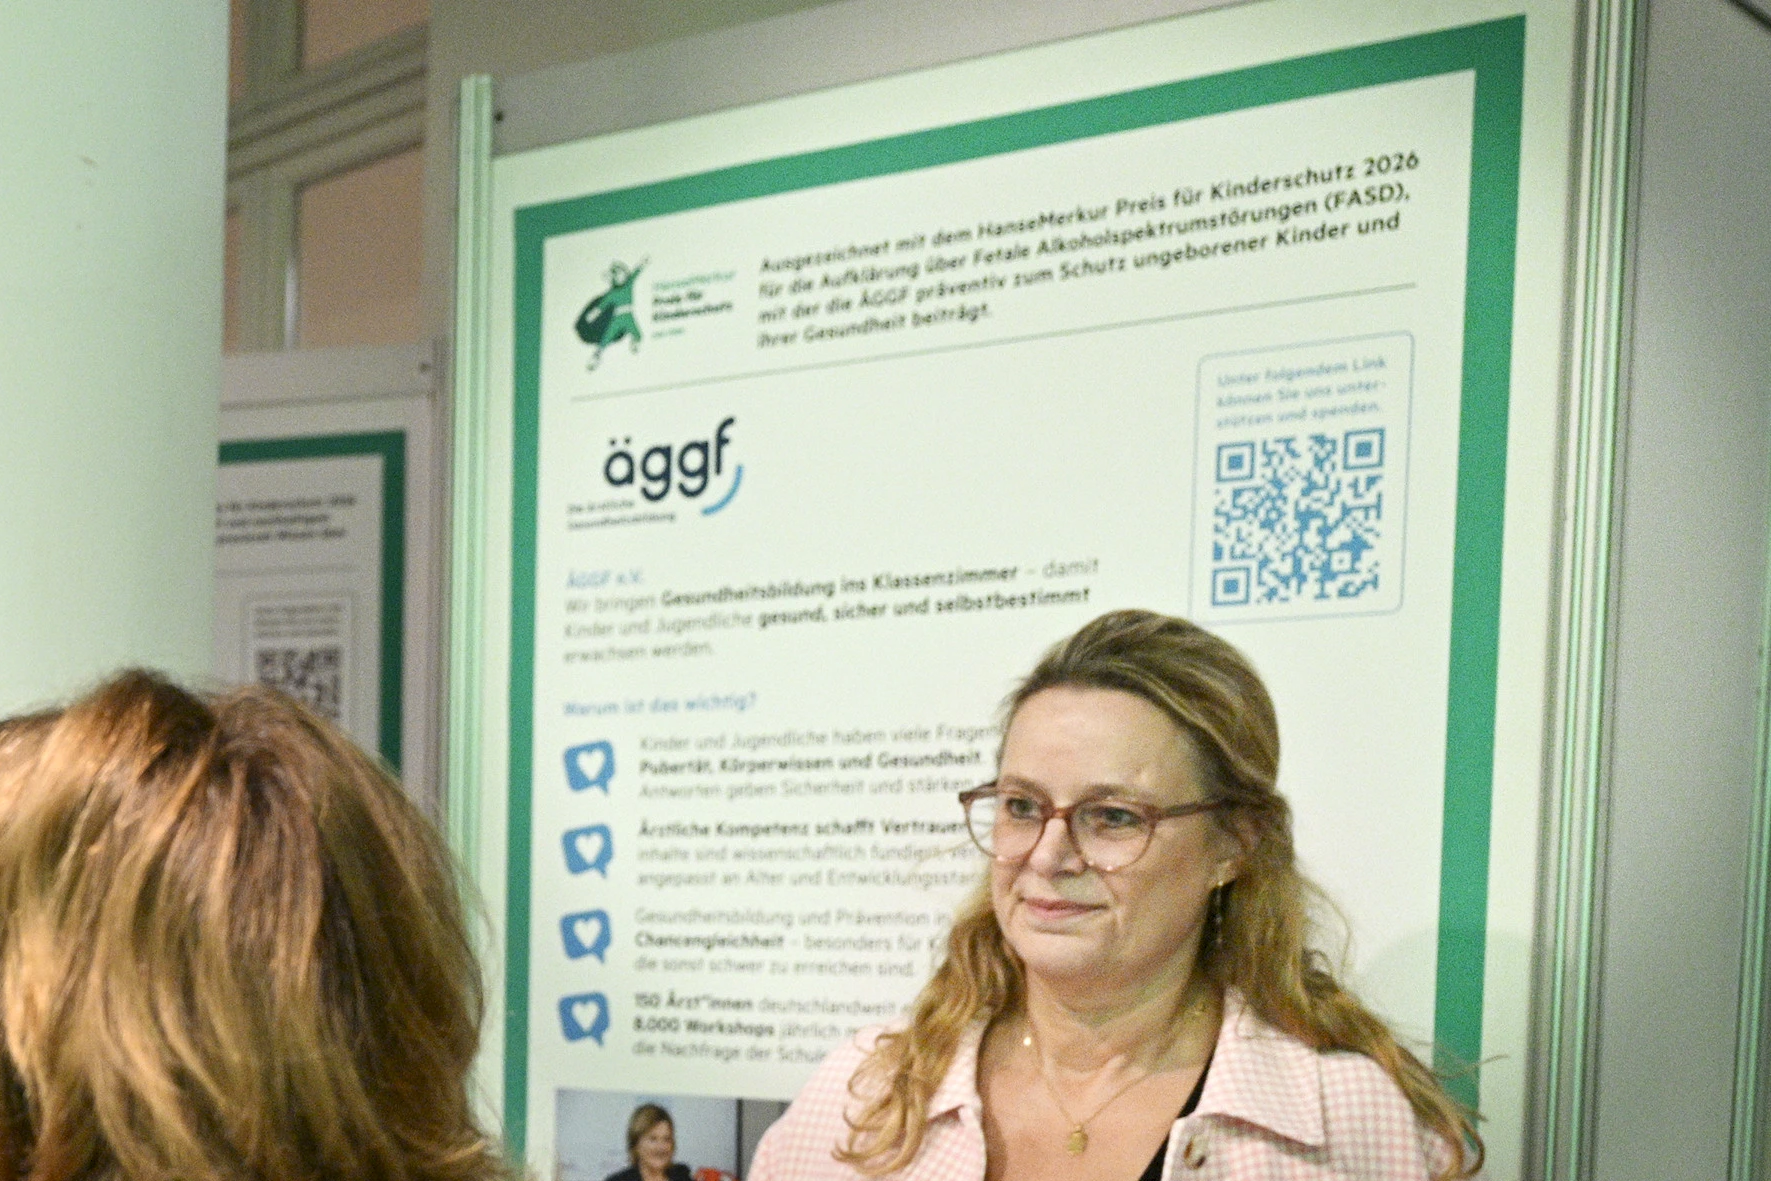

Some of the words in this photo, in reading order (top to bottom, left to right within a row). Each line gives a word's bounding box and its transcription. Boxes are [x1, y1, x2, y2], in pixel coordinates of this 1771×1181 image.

[895, 233, 926, 251] mit
[931, 226, 972, 248] dem
[977, 205, 1108, 239] HanseMerkur
[1116, 192, 1166, 215] Preis
[1174, 186, 1203, 206] für
[1211, 164, 1355, 201] Kinderschutz
[1364, 150, 1420, 178] 2026
[758, 281, 783, 299] für
[788, 277, 814, 296] die
[925, 254, 967, 274] über
[1037, 200, 1318, 256] Alkoholspektrumstörungen
[758, 305, 786, 324] mit
[791, 301, 820, 320] der
[825, 296, 852, 315] die
[916, 274, 1006, 302] präventiv
[1013, 266, 1054, 288] zum
[1059, 255, 1125, 281] Schutz
[1133, 234, 1267, 272] ungeborener
[1275, 219, 1350, 247] Kinder
[1358, 210, 1401, 236] und
[1352, 356, 1387, 371] Link
[1277, 388, 1300, 402] Sie
[1304, 386, 1332, 398] uns
[1277, 406, 1307, 422] und
[603, 415, 736, 503] äggf
[840, 575, 866, 592] ins
[872, 566, 1017, 591] Klassenzimmer
[1042, 557, 1098, 578] damit
[618, 618, 651, 636] und
[833, 600, 886, 620] sicher
[892, 596, 930, 616] und
[935, 587, 1090, 612] selbstbestimmt
[649, 695, 679, 713] das
[694, 733, 726, 750] und
[838, 753, 873, 769] und
[869, 777, 904, 794] und
[798, 909, 831, 926] und
